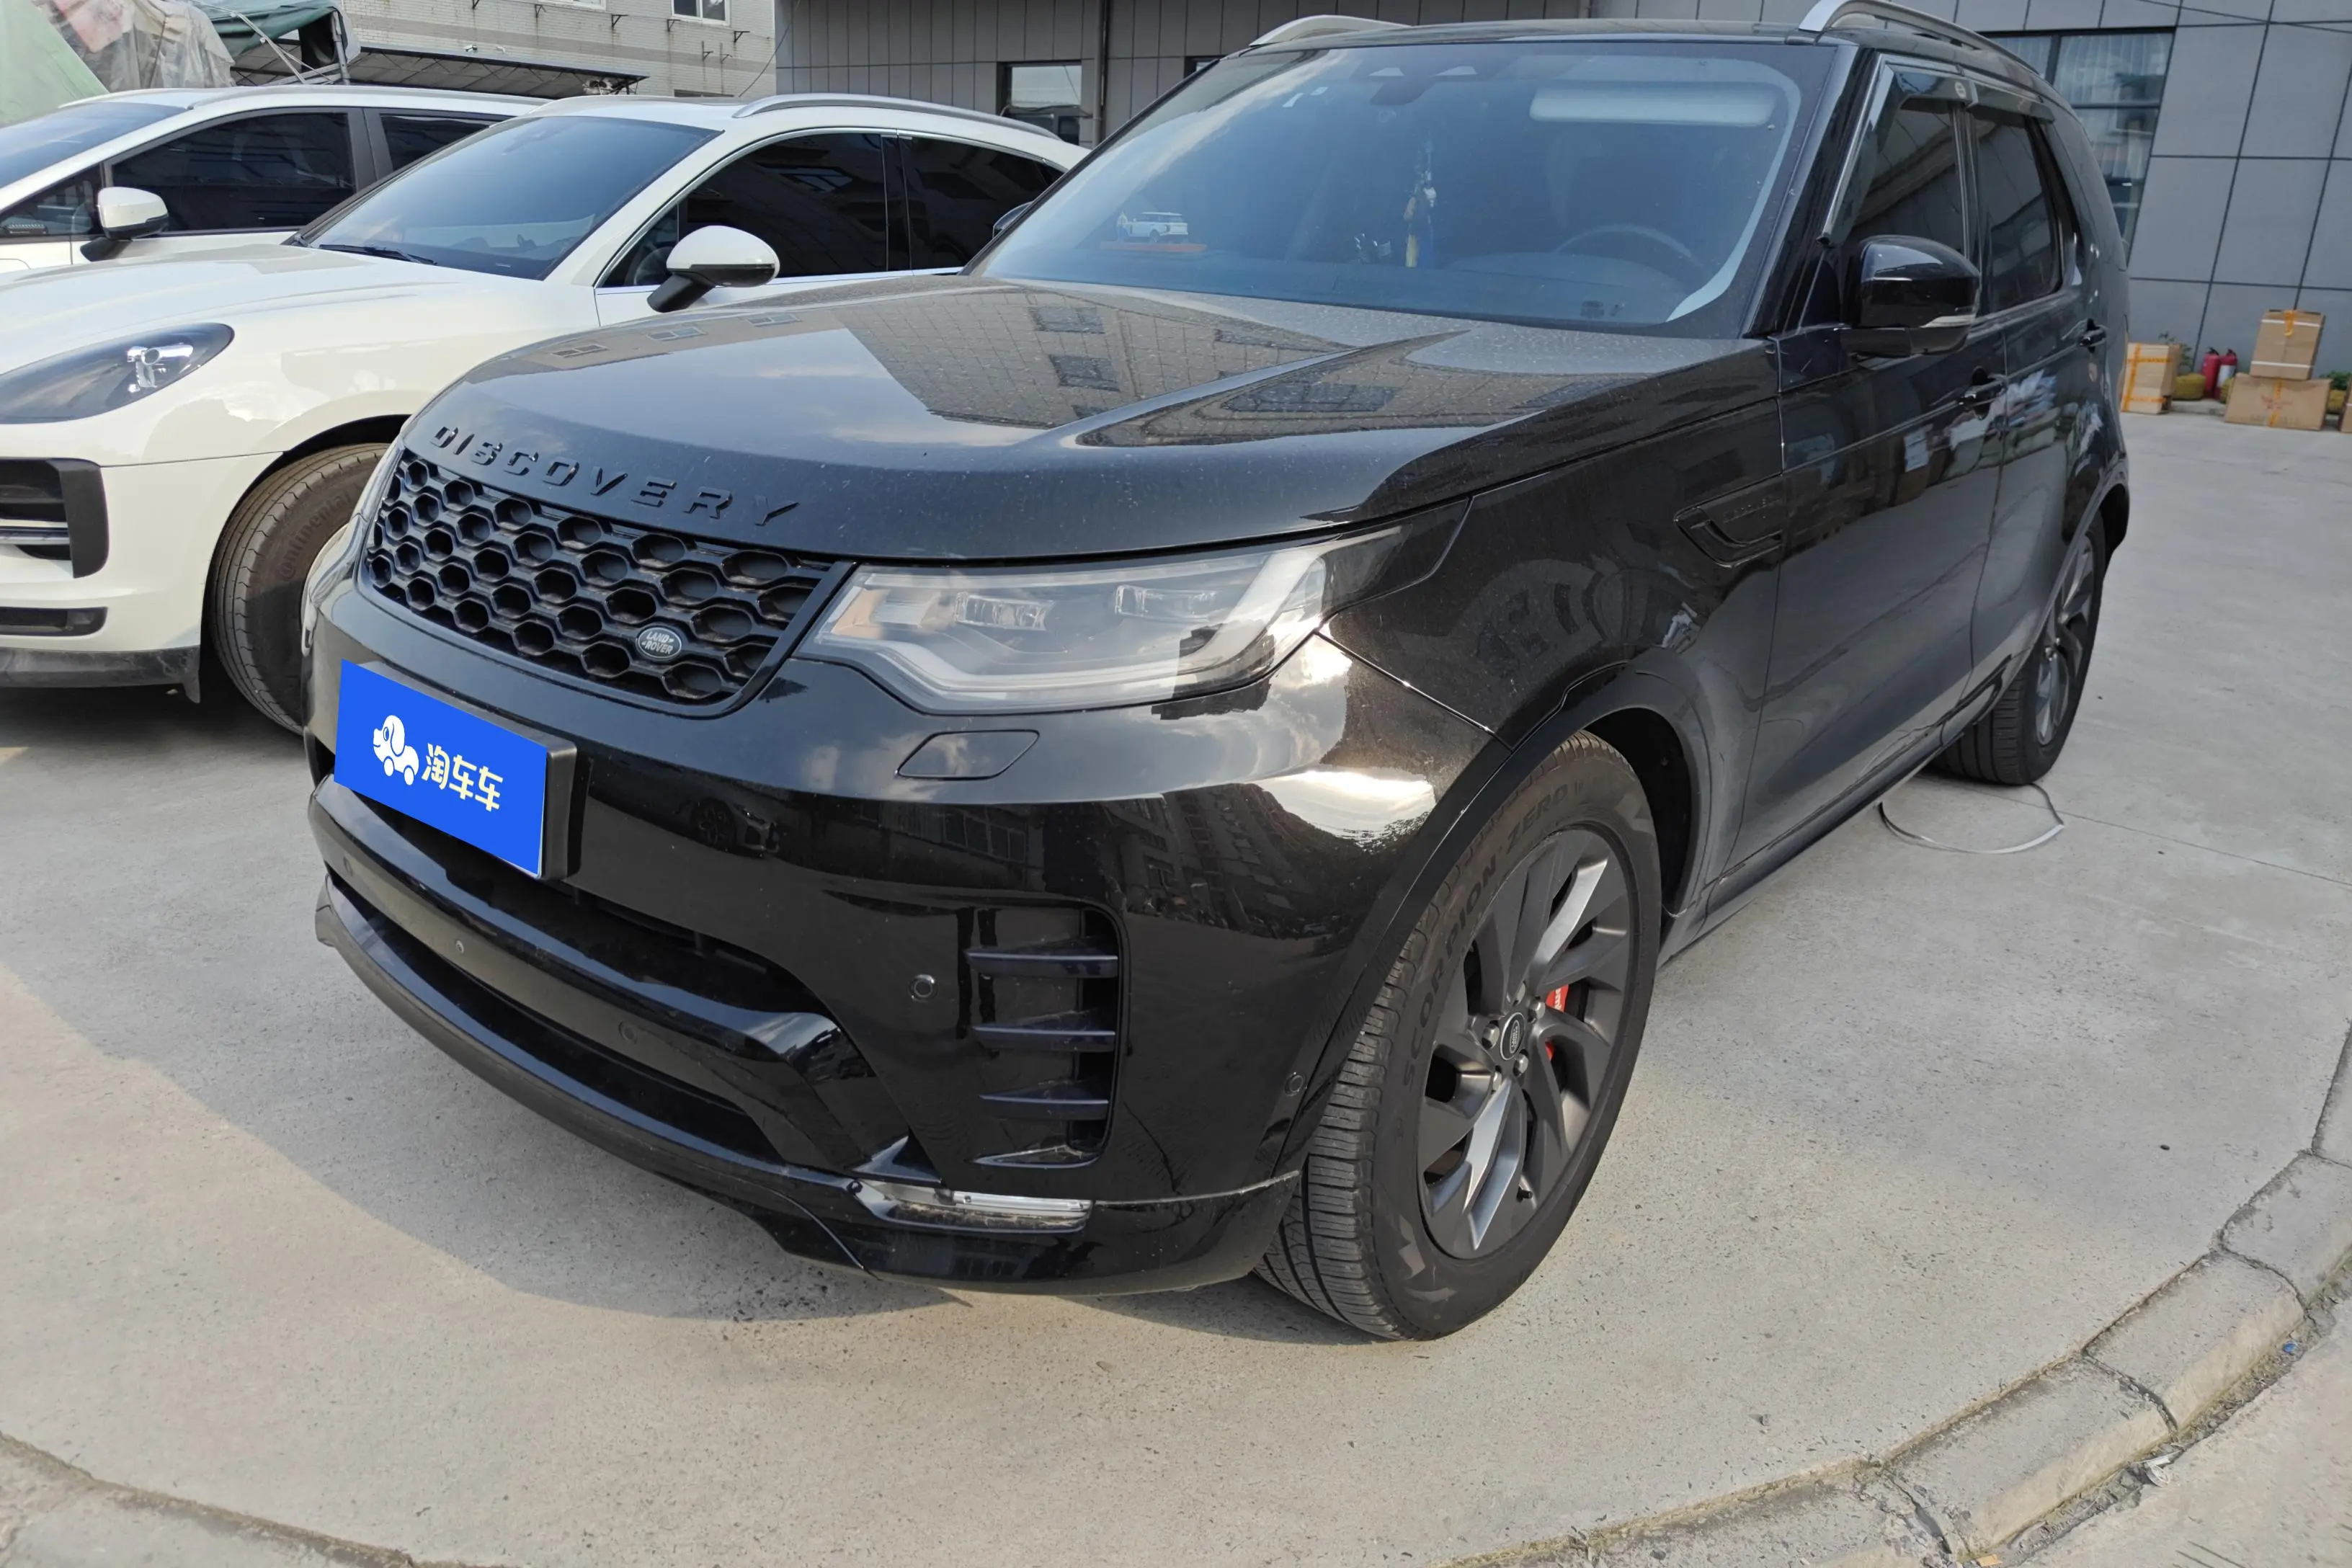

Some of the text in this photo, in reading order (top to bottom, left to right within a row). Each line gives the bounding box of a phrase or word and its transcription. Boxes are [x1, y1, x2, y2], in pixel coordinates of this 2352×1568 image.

[429, 425, 800, 526] DISCOVERY
[644, 640, 674, 655] ROVER
[646, 631, 670, 643] LAND
[1403, 783, 1569, 1092] SCORPION ZERO
